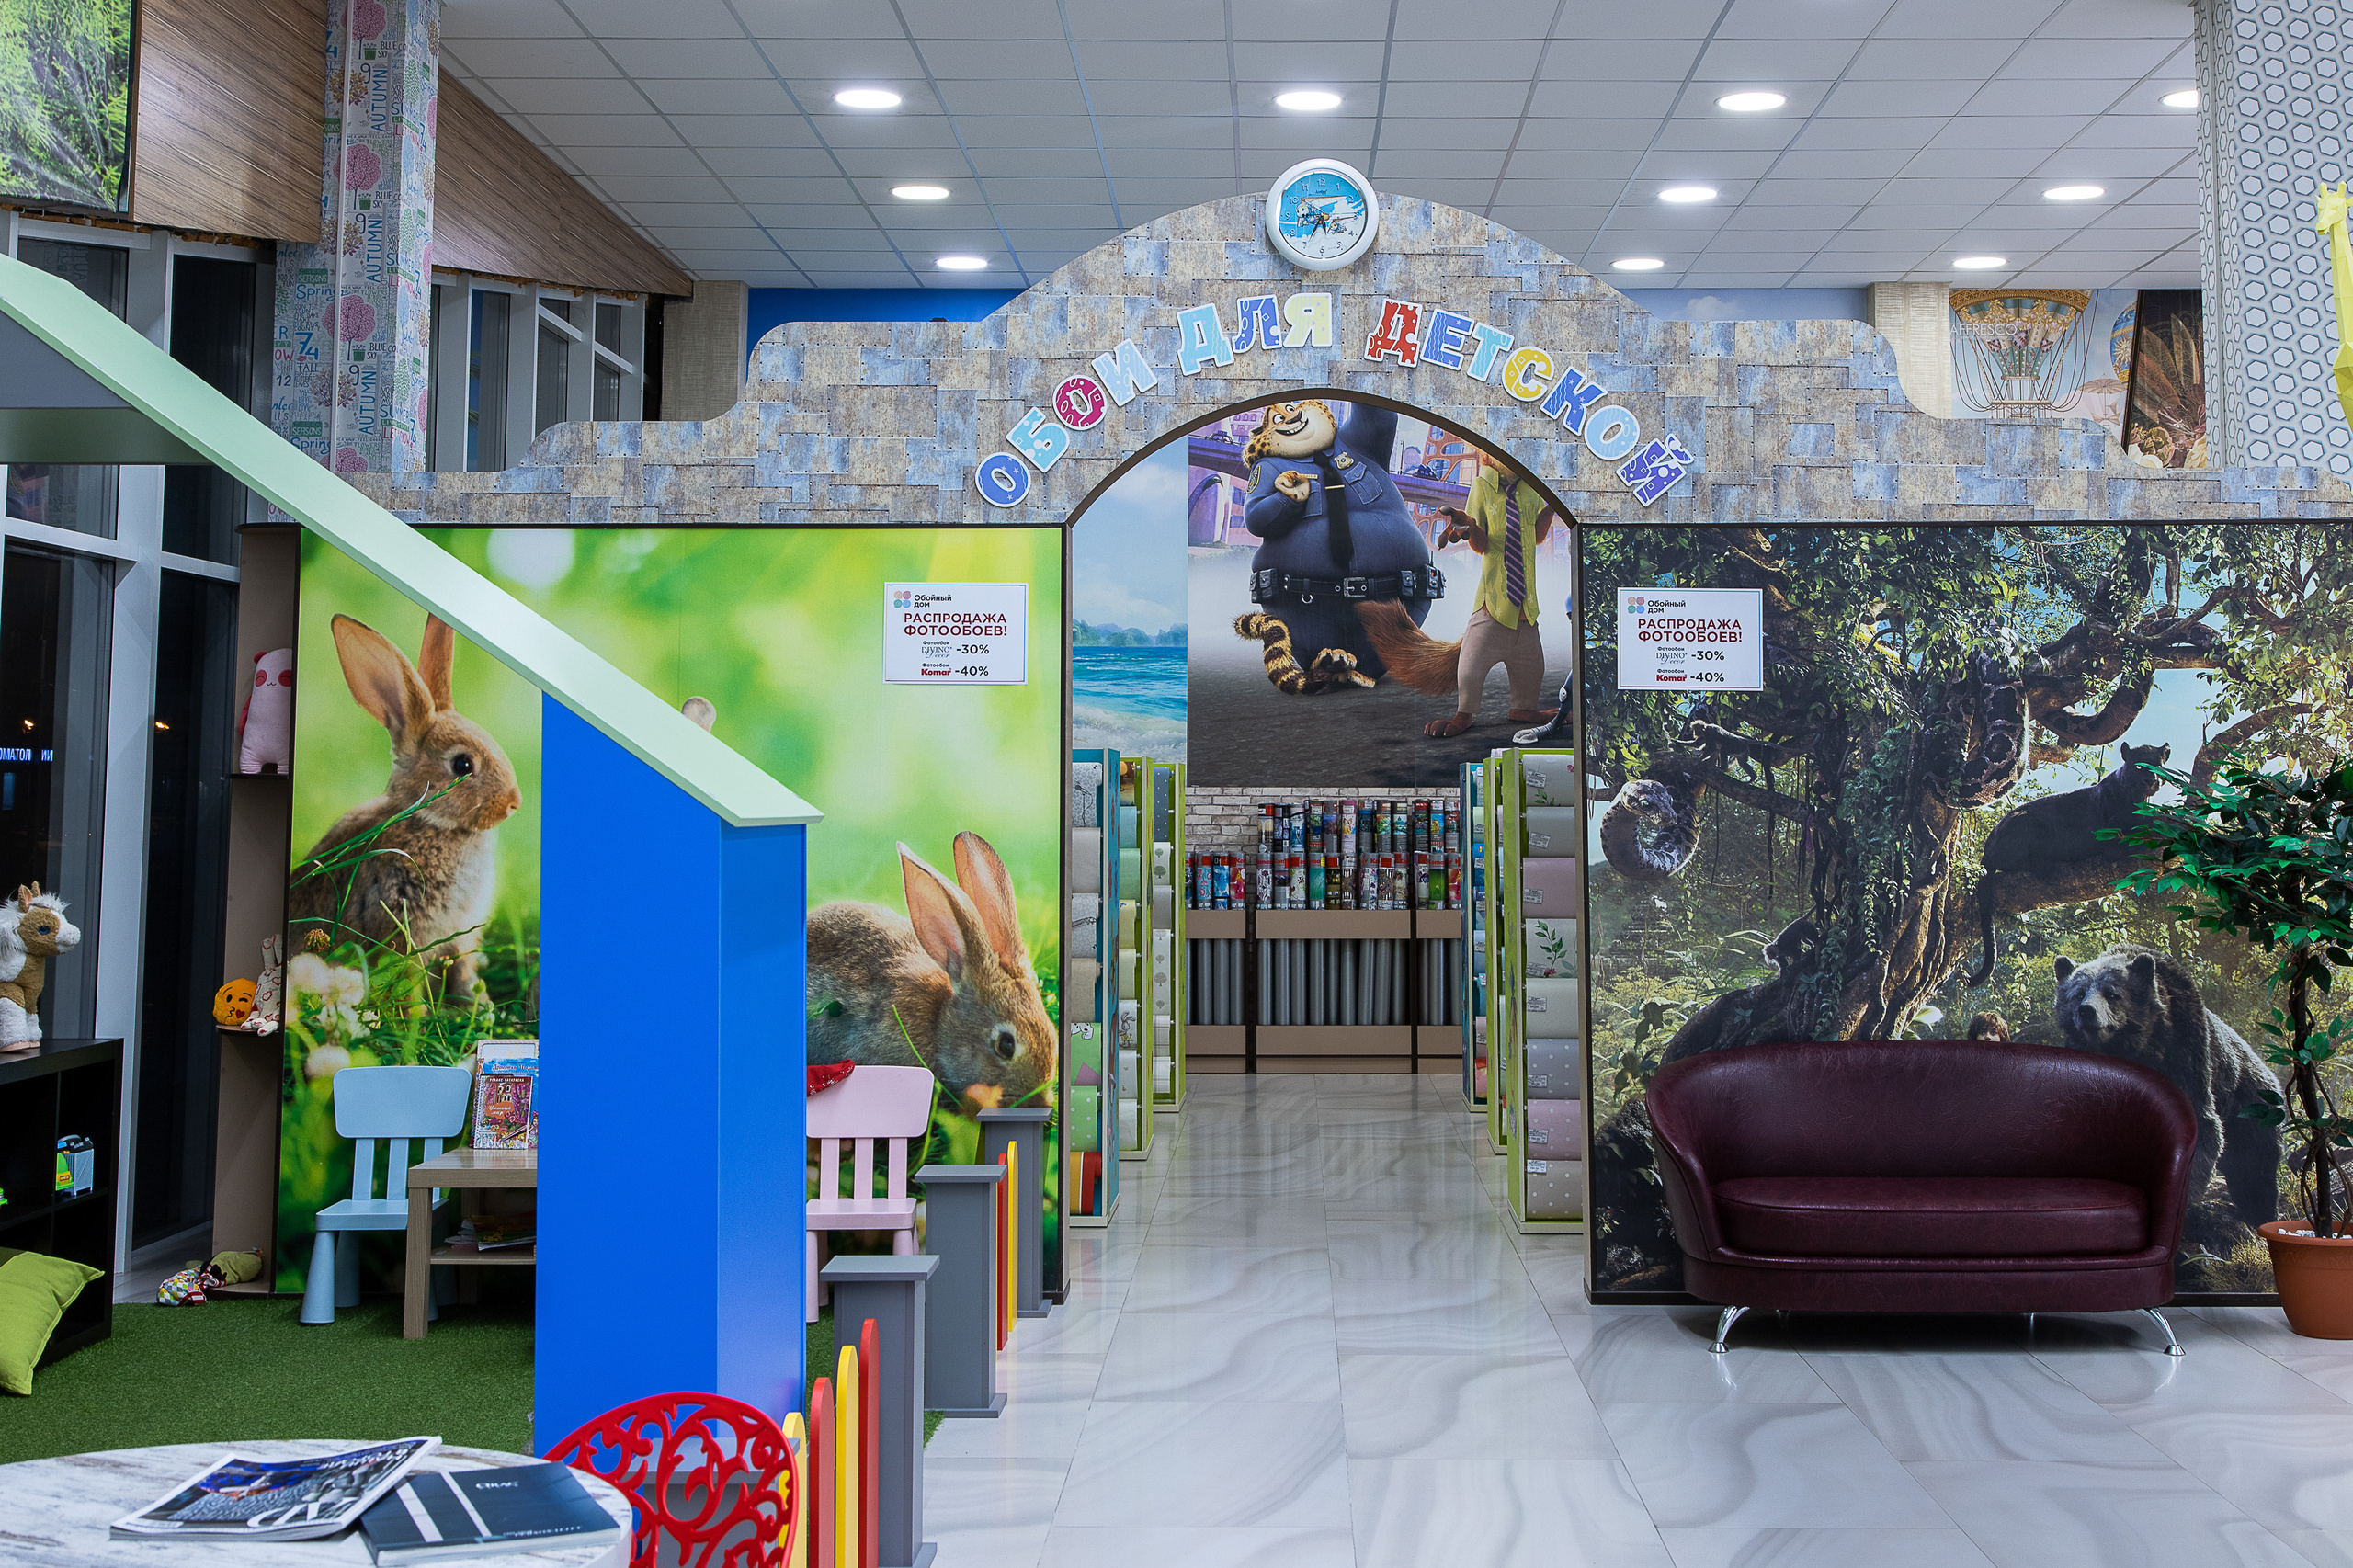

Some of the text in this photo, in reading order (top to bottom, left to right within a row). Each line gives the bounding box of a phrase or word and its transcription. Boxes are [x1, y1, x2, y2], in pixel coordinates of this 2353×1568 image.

[381, 41, 397, 50] BLUE
[360, 62, 371, 85] 9
[371, 70, 388, 132] AUTUMN
[375, 191, 392, 200] BLUE
[356, 213, 366, 233] 9
[366, 219, 383, 282] AUTUMN
[1950, 324, 2017, 335] AFFRESCO
[369, 342, 386, 351] BLUE
[277, 375, 291, 386] 12
[349, 365, 359, 386] 9
[359, 371, 376, 435] AUTUMN
[975, 292, 1695, 508] ОБОИ ДЛЯ ДЕТСКОЙ
[914, 594, 952, 602] Обойный
[904, 613, 1007, 624] РАСПРОДАЖА
[904, 625, 1007, 636] ФОТООБОЕВ!
[1638, 619, 1742, 631] РАСПРОДАЖА
[1638, 631, 1743, 642] ФОТООБОЕВ!
[956, 644, 989, 654] -30%
[1691, 651, 1724, 661] -30%
[954, 666, 989, 676] -40%
[1690, 672, 1724, 682] -40%
